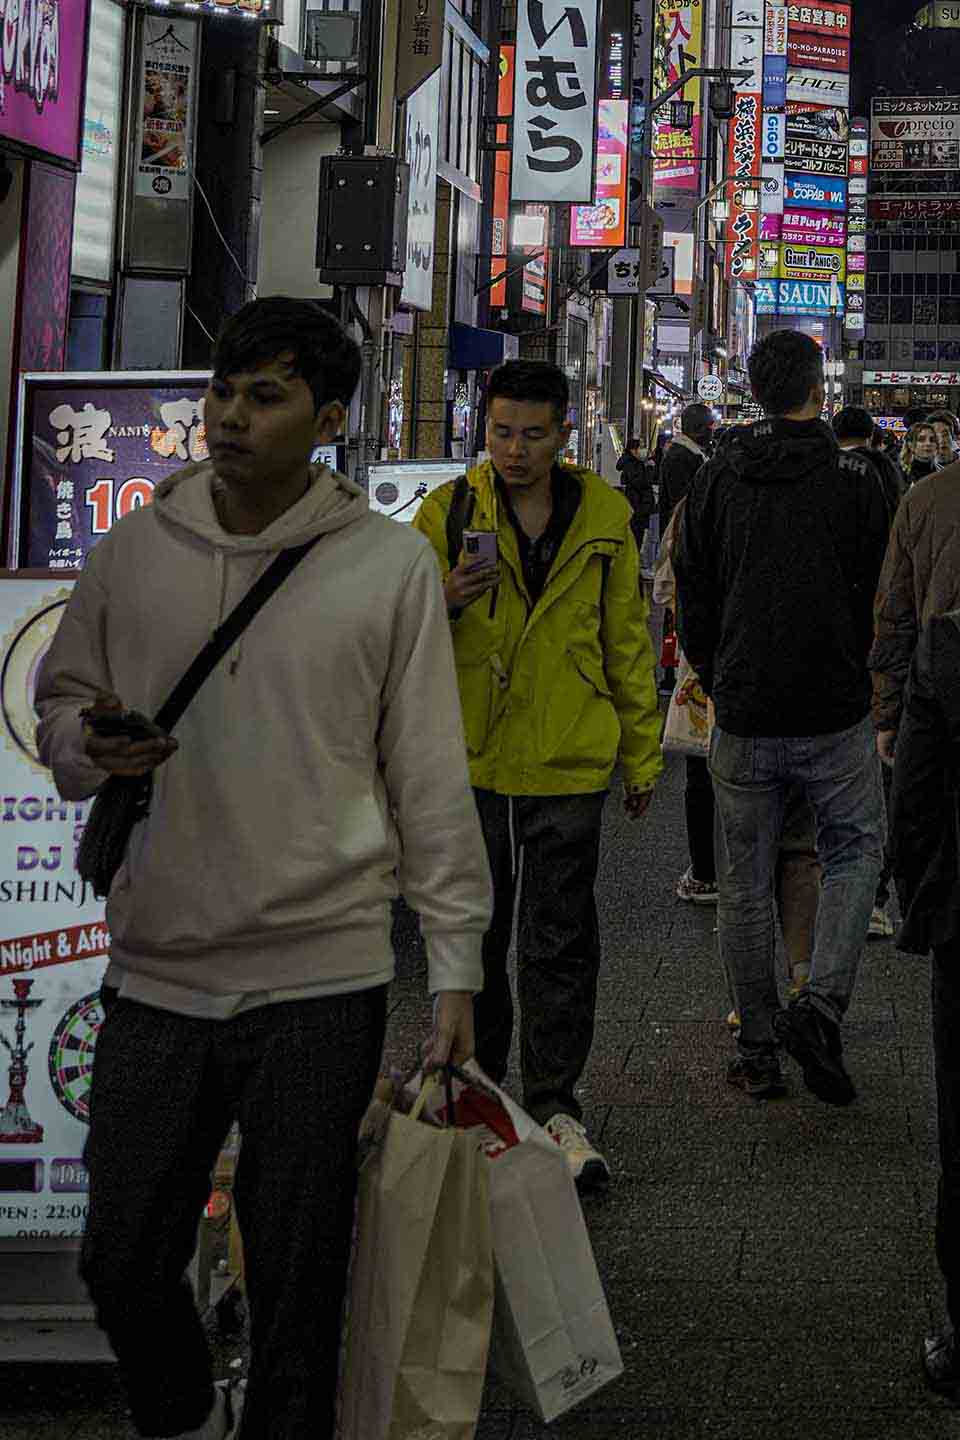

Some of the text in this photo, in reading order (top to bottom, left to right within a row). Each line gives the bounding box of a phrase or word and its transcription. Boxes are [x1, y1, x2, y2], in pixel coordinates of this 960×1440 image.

[788, 5, 847, 29] 全店営業中
[786, 75, 849, 91] FACE
[874, 101, 960, 112] コミック&ネットカフェ
[767, 116, 779, 154] GiGO
[55, 480, 75, 539] 焼き鳥
[17, 845, 62, 871] DJ
[0, 934, 52, 968] Night
[56, 930, 72, 959] &
